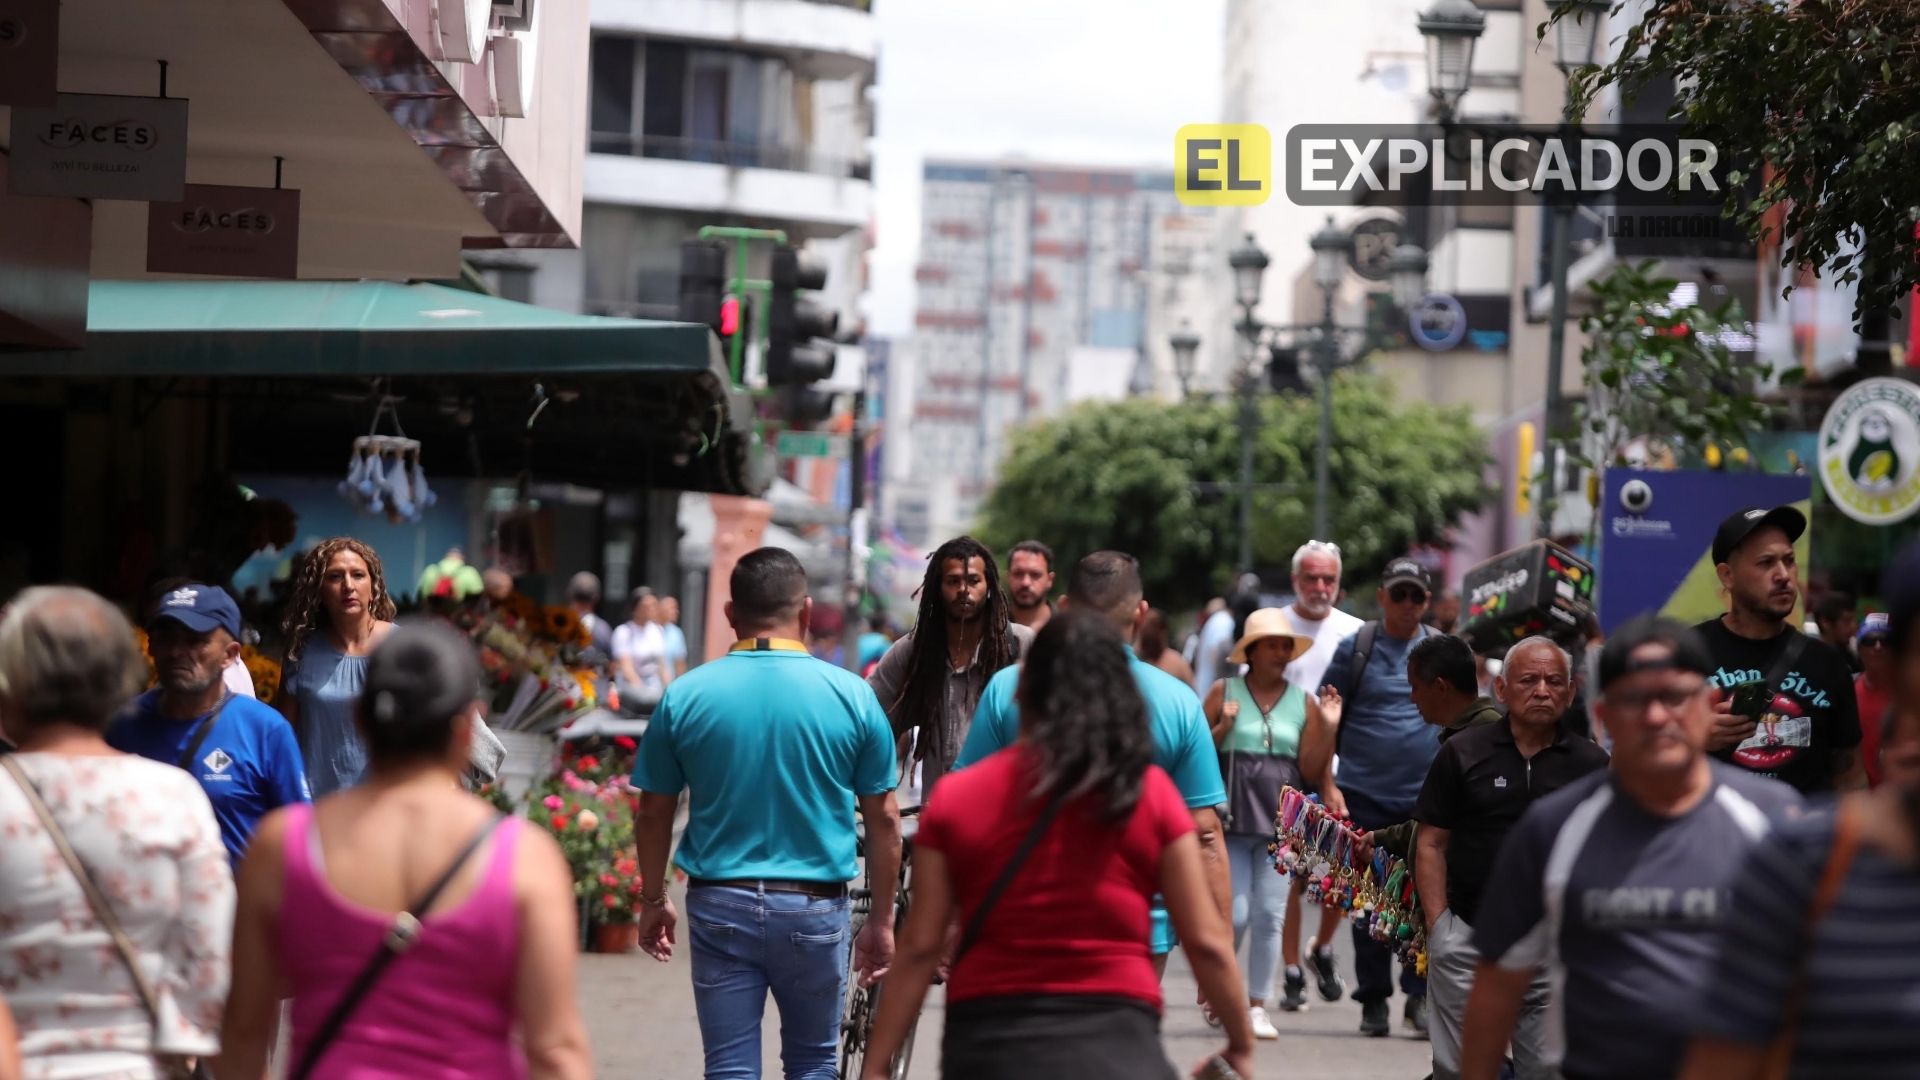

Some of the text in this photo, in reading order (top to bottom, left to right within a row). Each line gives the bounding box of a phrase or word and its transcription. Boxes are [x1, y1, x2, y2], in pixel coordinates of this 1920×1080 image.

[50, 123, 149, 145] FACES
[182, 210, 268, 230] FACES
[1708, 666, 1831, 708] rban Style
